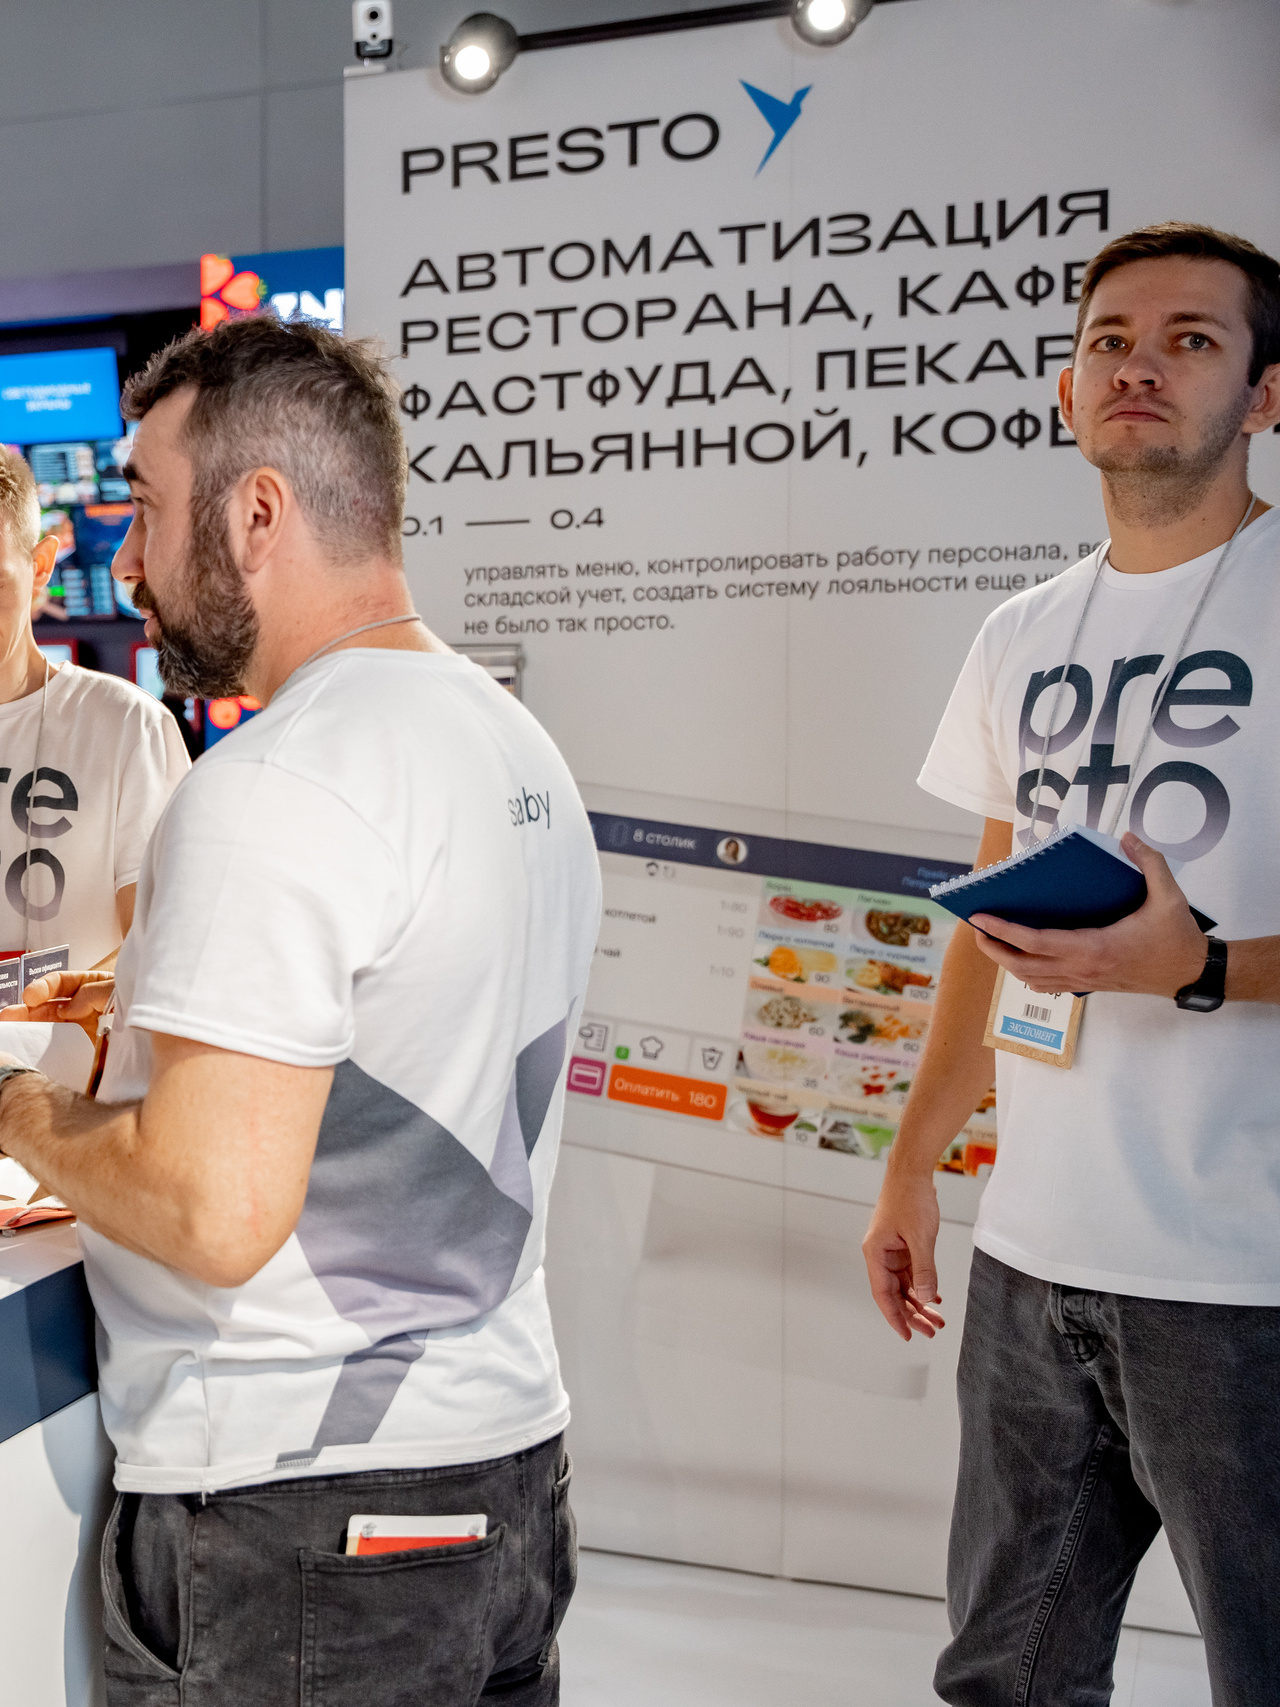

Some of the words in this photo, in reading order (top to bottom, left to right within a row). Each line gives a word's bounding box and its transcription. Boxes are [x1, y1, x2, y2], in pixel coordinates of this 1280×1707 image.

[401, 113, 720, 194] PRESTO
[400, 188, 1110, 298] АВТОМАТИЗАЦИЯ
[401, 283, 874, 358] РЕСТОРАНА,
[399, 357, 791, 421] ФАСТФУДА,
[406, 408, 867, 485] КАЛЬЯННОЙ,
[549, 507, 605, 531] 0.4
[464, 564, 568, 586] управлять
[575, 559, 639, 579] меню,
[647, 552, 828, 577] контролировать
[836, 545, 920, 571] работу
[927, 542, 1068, 570] персонала,
[464, 586, 570, 608] складской
[577, 587, 626, 608] учет,
[632, 584, 718, 603] создать
[724, 576, 819, 600] систему
[826, 572, 967, 596] лояльности
[975, 570, 1026, 592] еще
[464, 620, 489, 636] не
[495, 615, 550, 635] было
[557, 616, 587, 632] так
[594, 613, 675, 636] просто.
[1019, 650, 1253, 772] pre
[508, 786, 550, 829] saby
[1016, 744, 1230, 863] sto
[633, 828, 644, 843] 8
[646, 832, 696, 850] столик
[1007, 1022, 1057, 1043] ЭКСПОНЕНТ
[614, 1078, 681, 1102] Оплатить
[690, 1091, 717, 1109] 180
